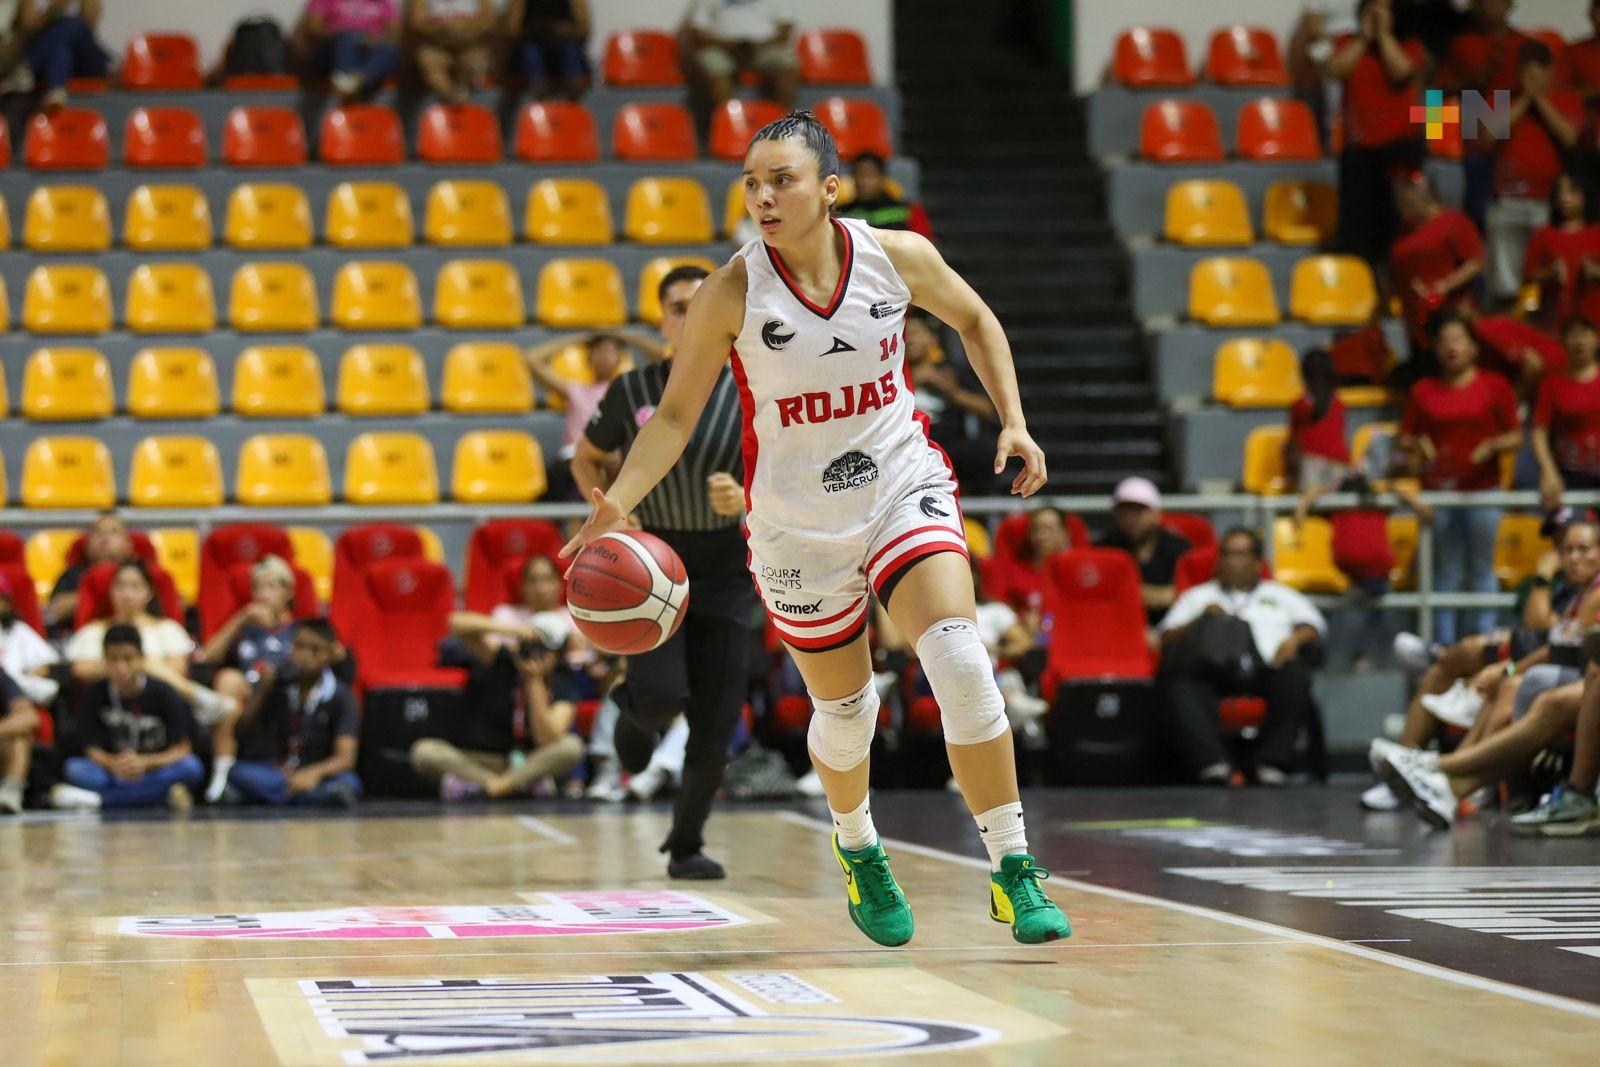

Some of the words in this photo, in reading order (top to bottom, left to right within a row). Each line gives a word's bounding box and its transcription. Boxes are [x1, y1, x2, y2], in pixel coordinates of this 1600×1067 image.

[880, 333, 898, 361] 14
[774, 370, 898, 427] ROJAS
[824, 470, 879, 493] VERACRUZ
[775, 598, 823, 615] Comex
